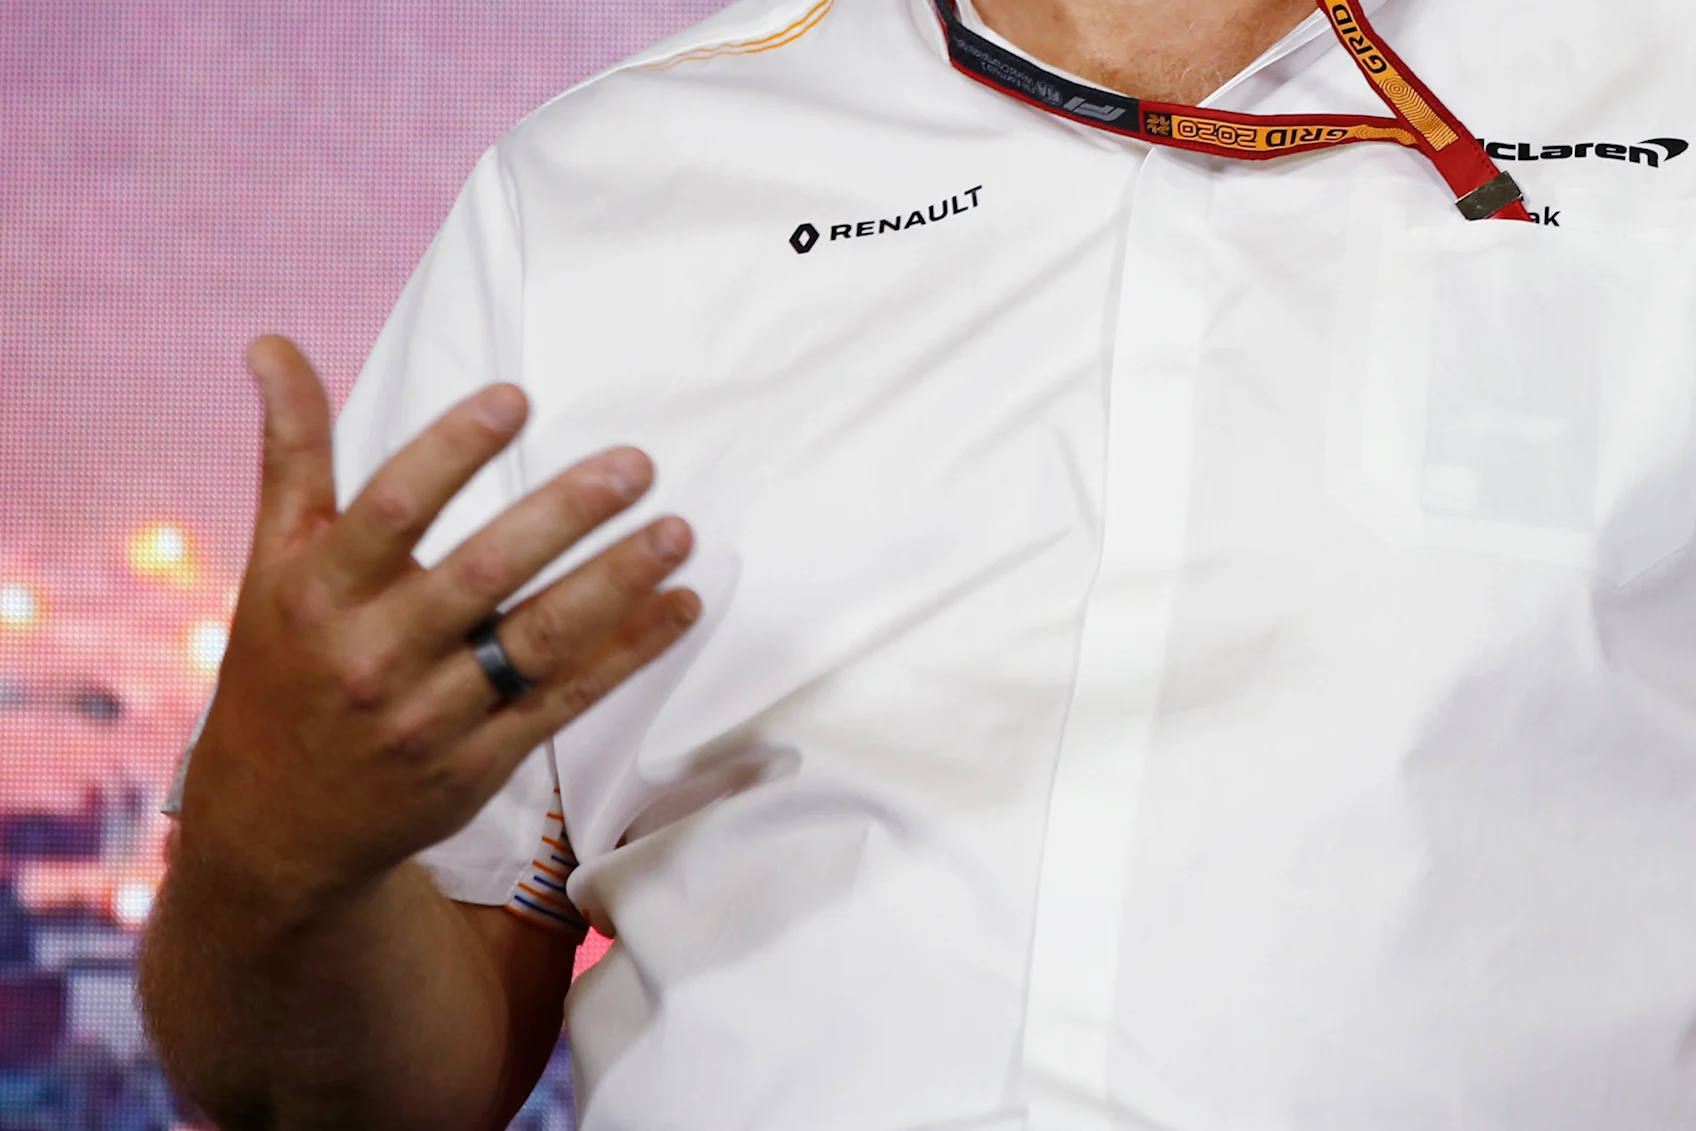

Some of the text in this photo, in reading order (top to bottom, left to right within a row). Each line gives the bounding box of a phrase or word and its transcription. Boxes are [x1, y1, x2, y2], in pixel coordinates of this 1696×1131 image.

[1331, 2, 1387, 74] GRID
[1178, 118, 1350, 149] GRID 2020
[1476, 138, 1659, 168] cLaren
[830, 184, 983, 241] RENAULT
